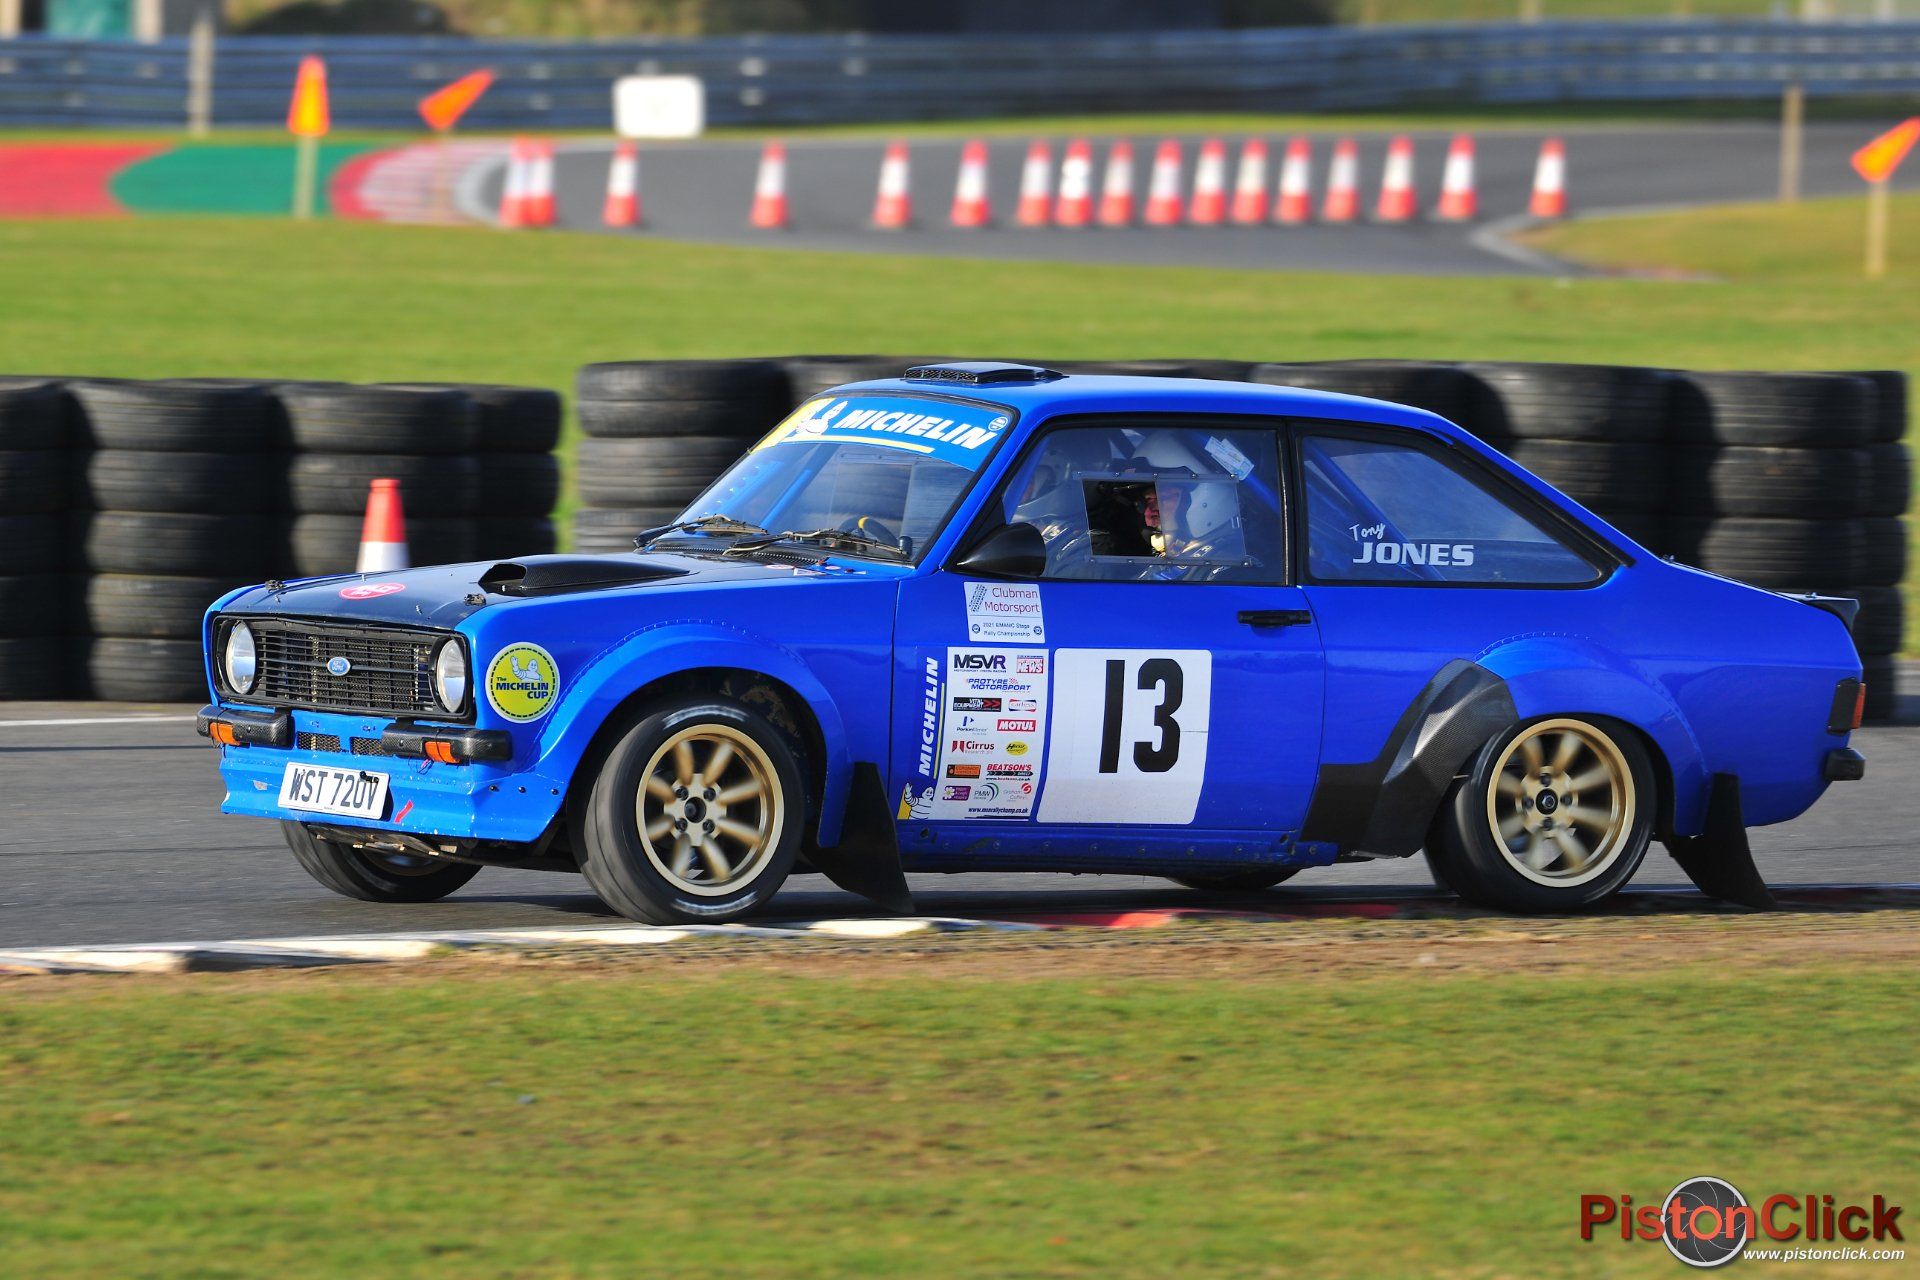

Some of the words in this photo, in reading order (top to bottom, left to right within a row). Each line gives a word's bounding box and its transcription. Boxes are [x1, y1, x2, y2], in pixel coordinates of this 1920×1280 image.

[833, 409, 998, 450] MICHELIN
[1349, 523, 1386, 541] Tony
[1353, 542, 1475, 566] JONES
[992, 587, 1038, 599] Clubman
[984, 601, 1041, 614] Motorsport
[953, 654, 1006, 669] MSVR
[496, 682, 549, 691] MICHELIN
[527, 691, 549, 699] CUP
[918, 657, 938, 777] MICHELIN
[1099, 658, 1184, 773] 13
[998, 720, 1035, 731] MOTUL
[966, 741, 995, 750] Cirrus
[289, 767, 328, 804] WST
[331, 772, 379, 810] 720V
